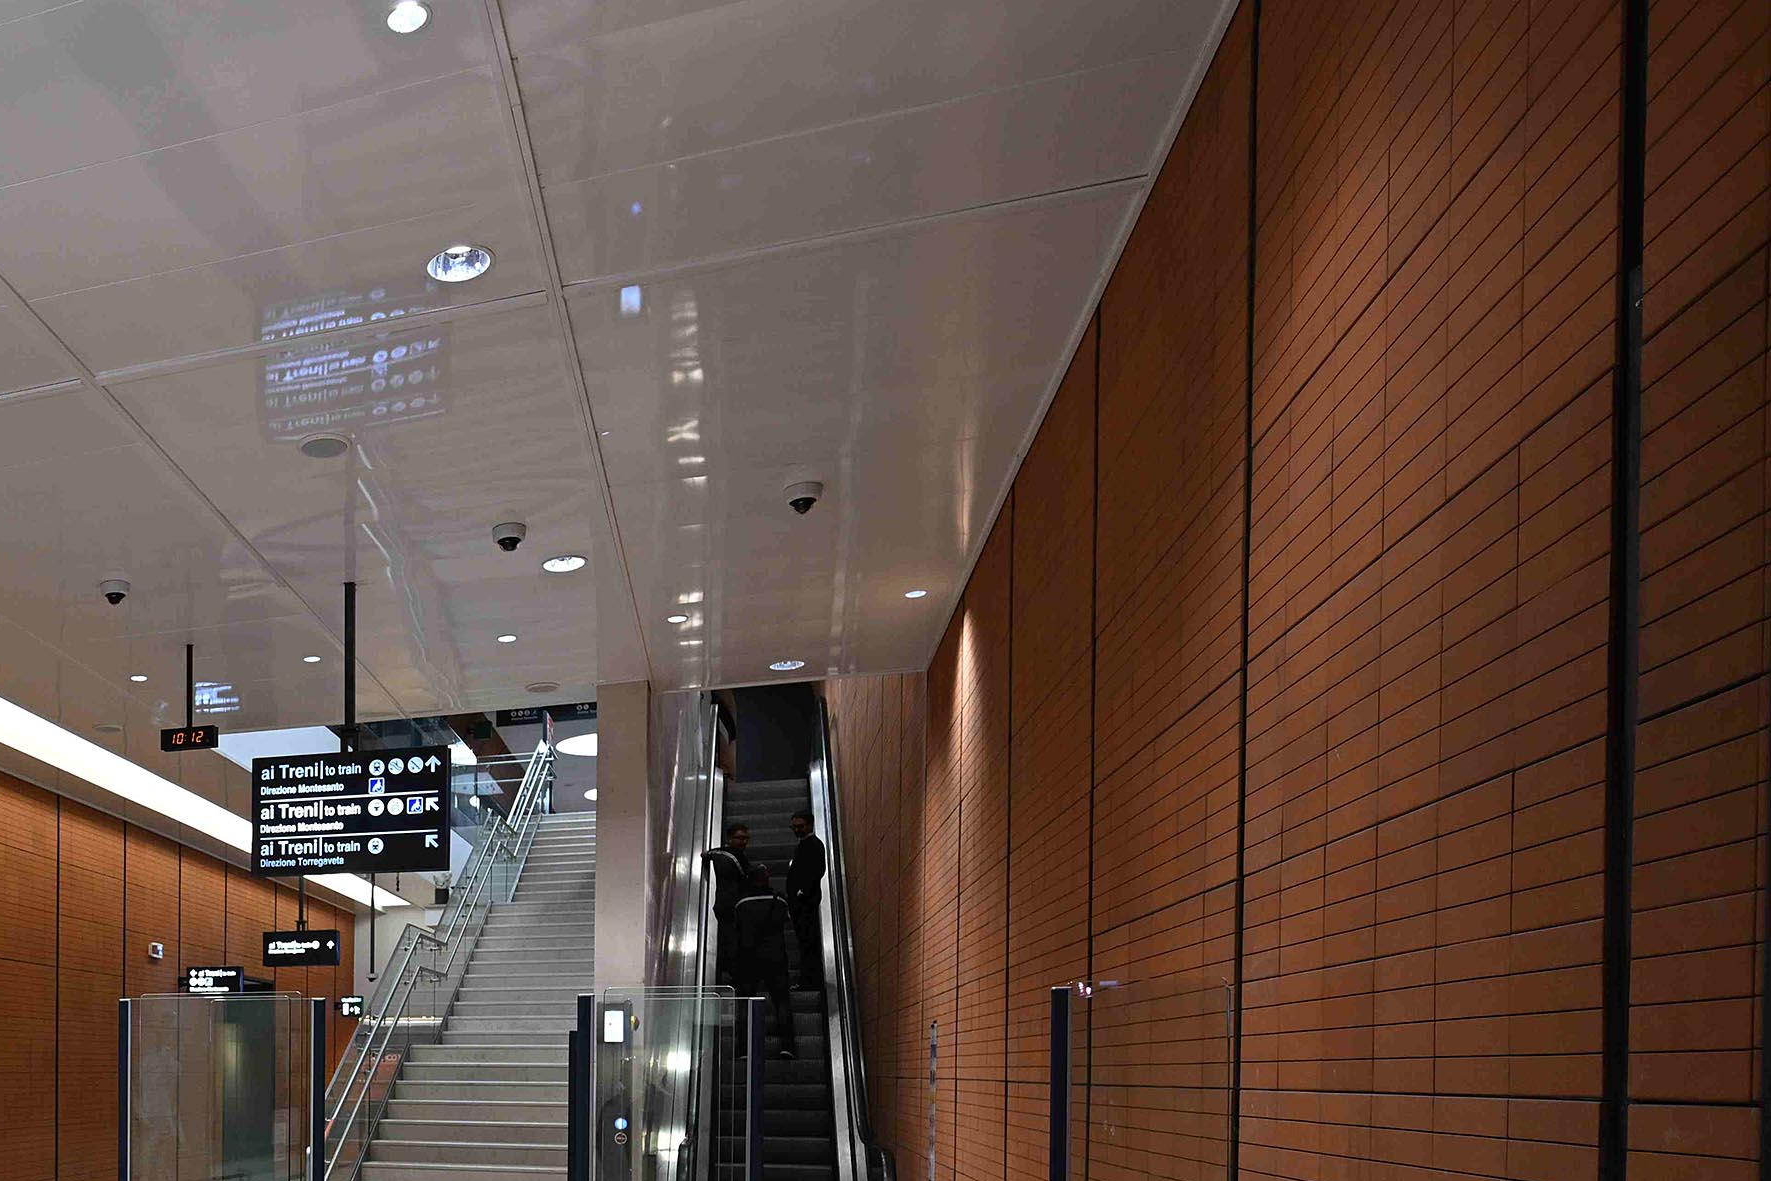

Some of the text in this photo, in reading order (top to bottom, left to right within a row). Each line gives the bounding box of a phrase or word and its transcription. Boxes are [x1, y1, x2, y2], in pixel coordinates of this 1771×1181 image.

[172, 730, 204, 745] 10:12
[261, 762, 362, 781] ai Treni to train
[260, 781, 345, 796] Direzione Montesanto
[260, 802, 362, 820] ai Treni to train
[260, 820, 345, 834] Direzione Montesanto
[260, 839, 361, 857] ai Treni to train
[260, 856, 345, 868] Direzione Torregaveta
